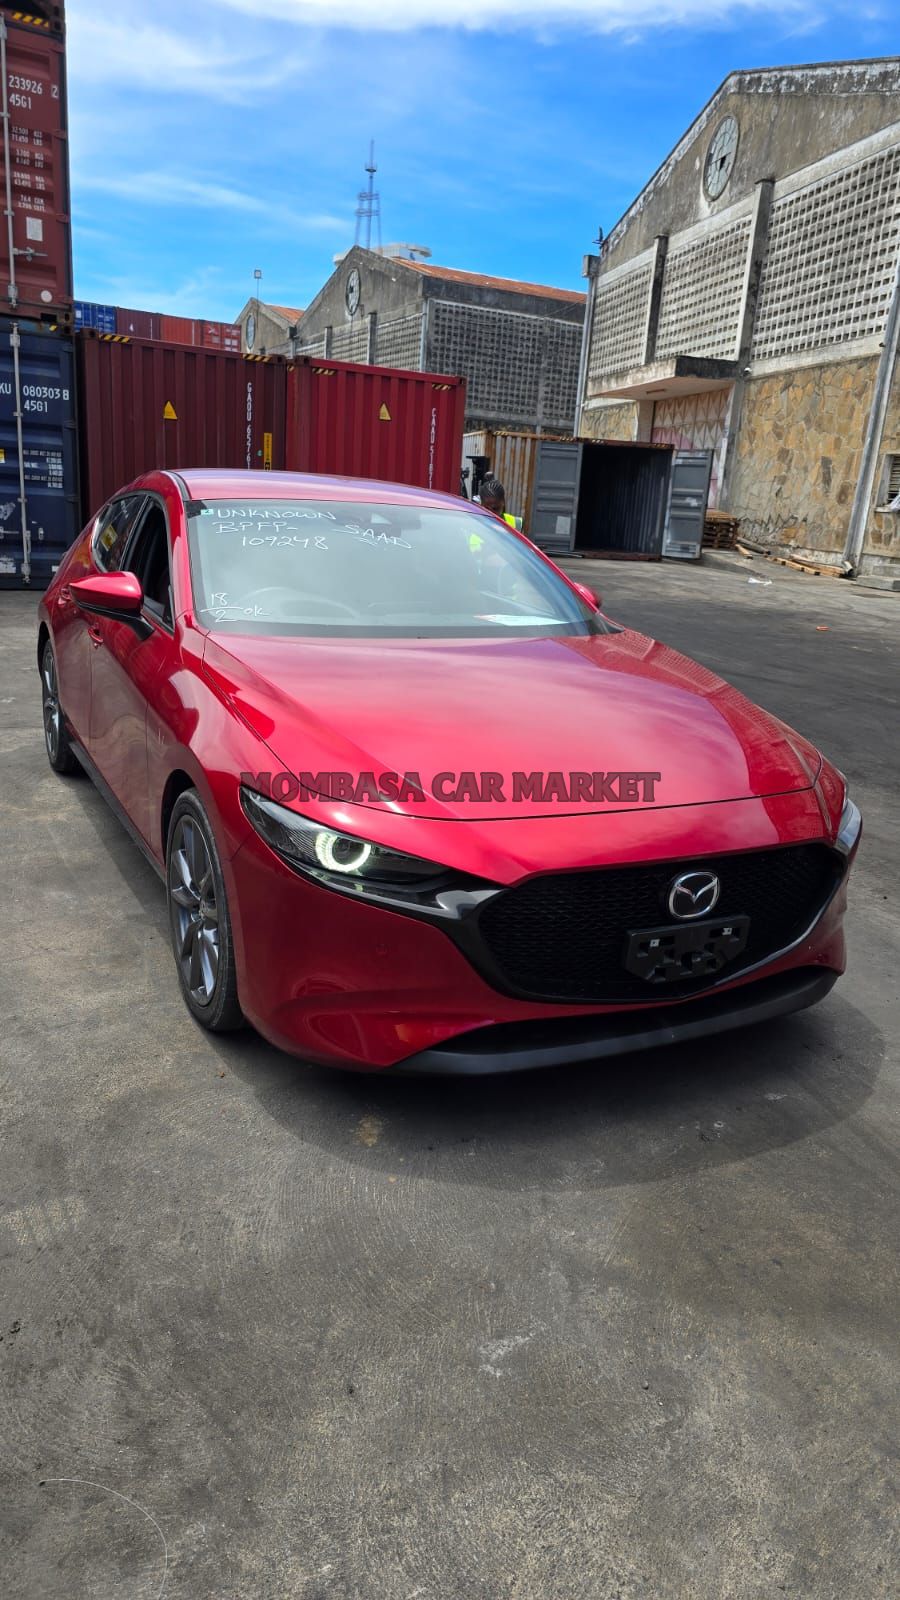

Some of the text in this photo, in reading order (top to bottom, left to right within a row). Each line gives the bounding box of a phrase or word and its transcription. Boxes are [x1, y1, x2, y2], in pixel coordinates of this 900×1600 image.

[8, 74, 59, 99] 233926 2
[9, 93, 32, 110] 45G1
[22, 385, 61, 400] 080303
[24, 399, 48, 413] 45G1
[217, 508, 337, 520] UNKNOWN
[242, 535, 329, 550] 109248
[332, 524, 412, 549] SAAD
